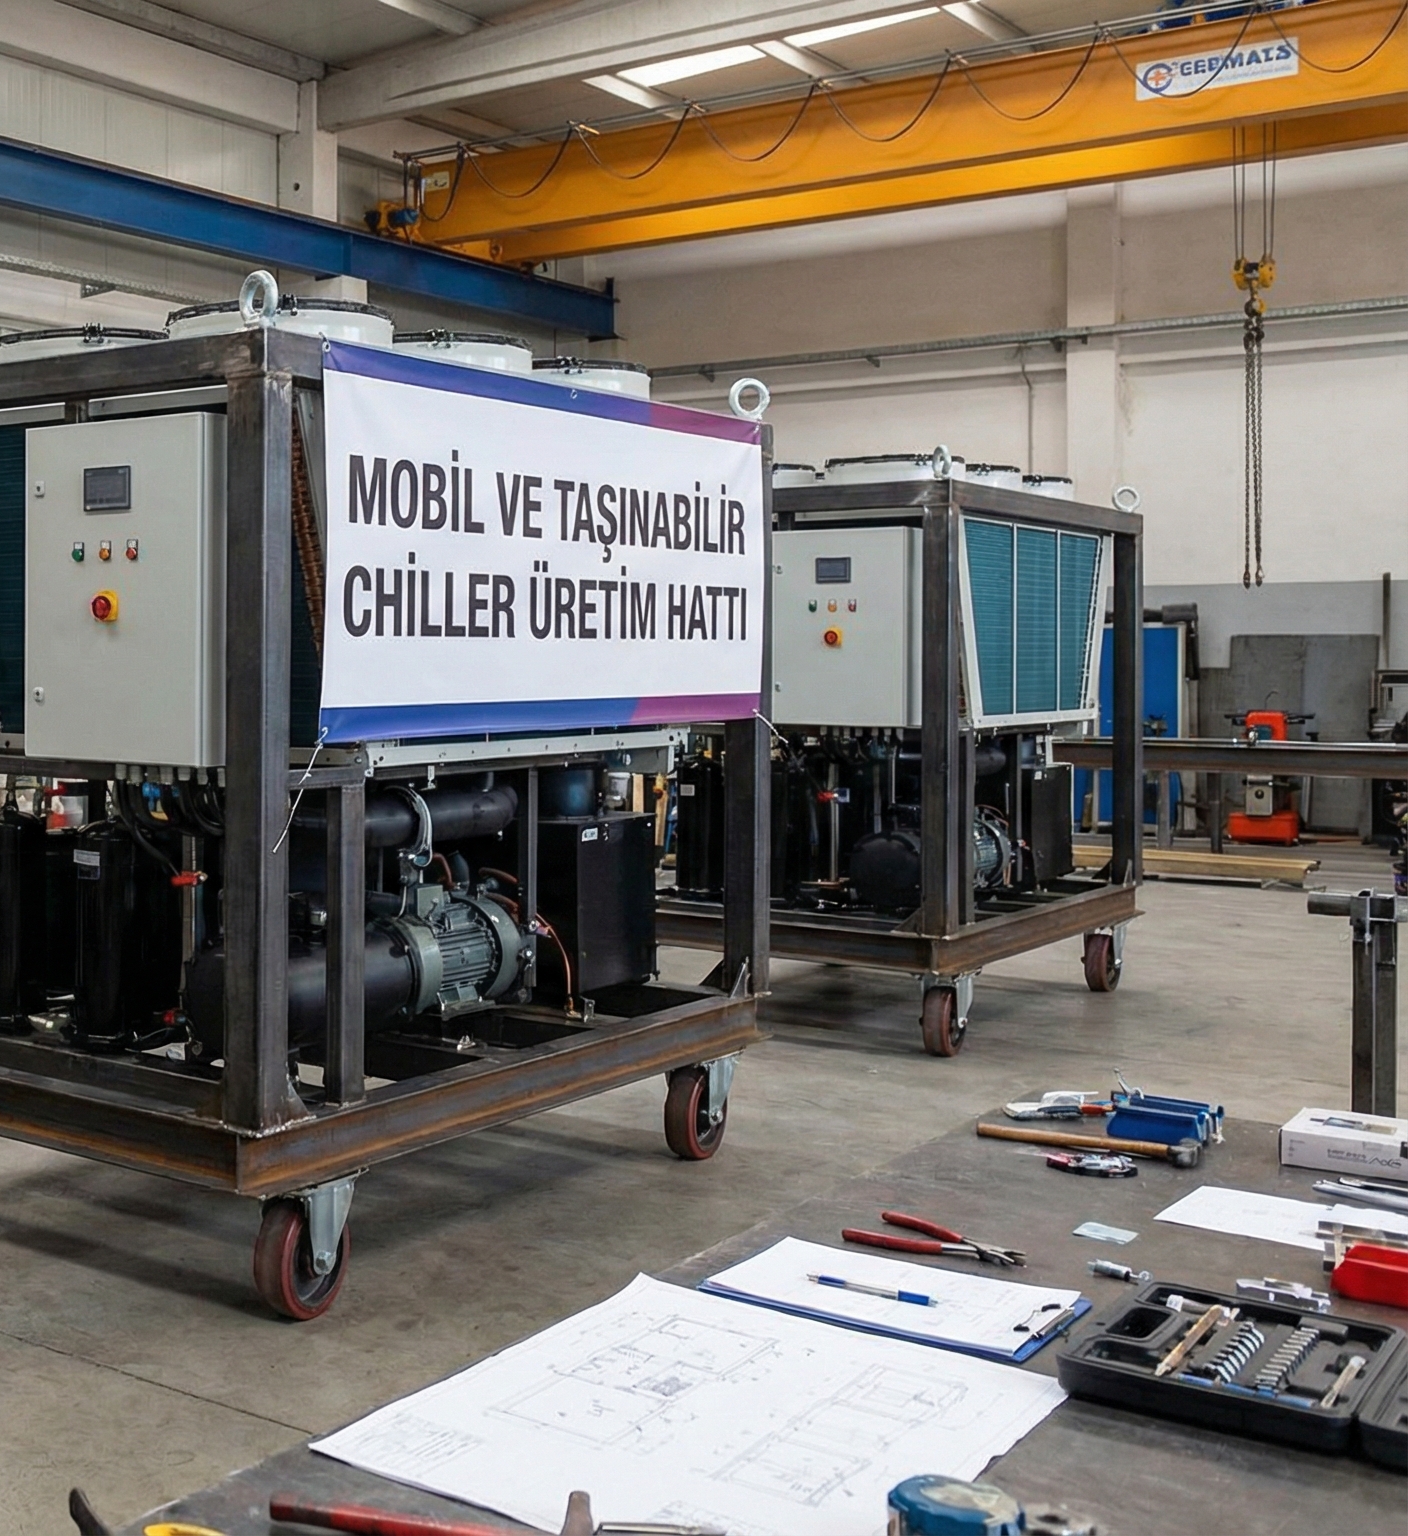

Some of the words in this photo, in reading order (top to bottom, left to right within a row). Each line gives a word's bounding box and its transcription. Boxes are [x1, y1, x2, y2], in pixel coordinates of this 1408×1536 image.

[348, 450, 485, 534] MOBİL
[496, 472, 543, 539] VE
[554, 479, 745, 564] TAŞINABİLİR
[343, 552, 516, 638] CHİLLER
[529, 560, 656, 640] ÜRETİM
[667, 583, 747, 641] HATTI
